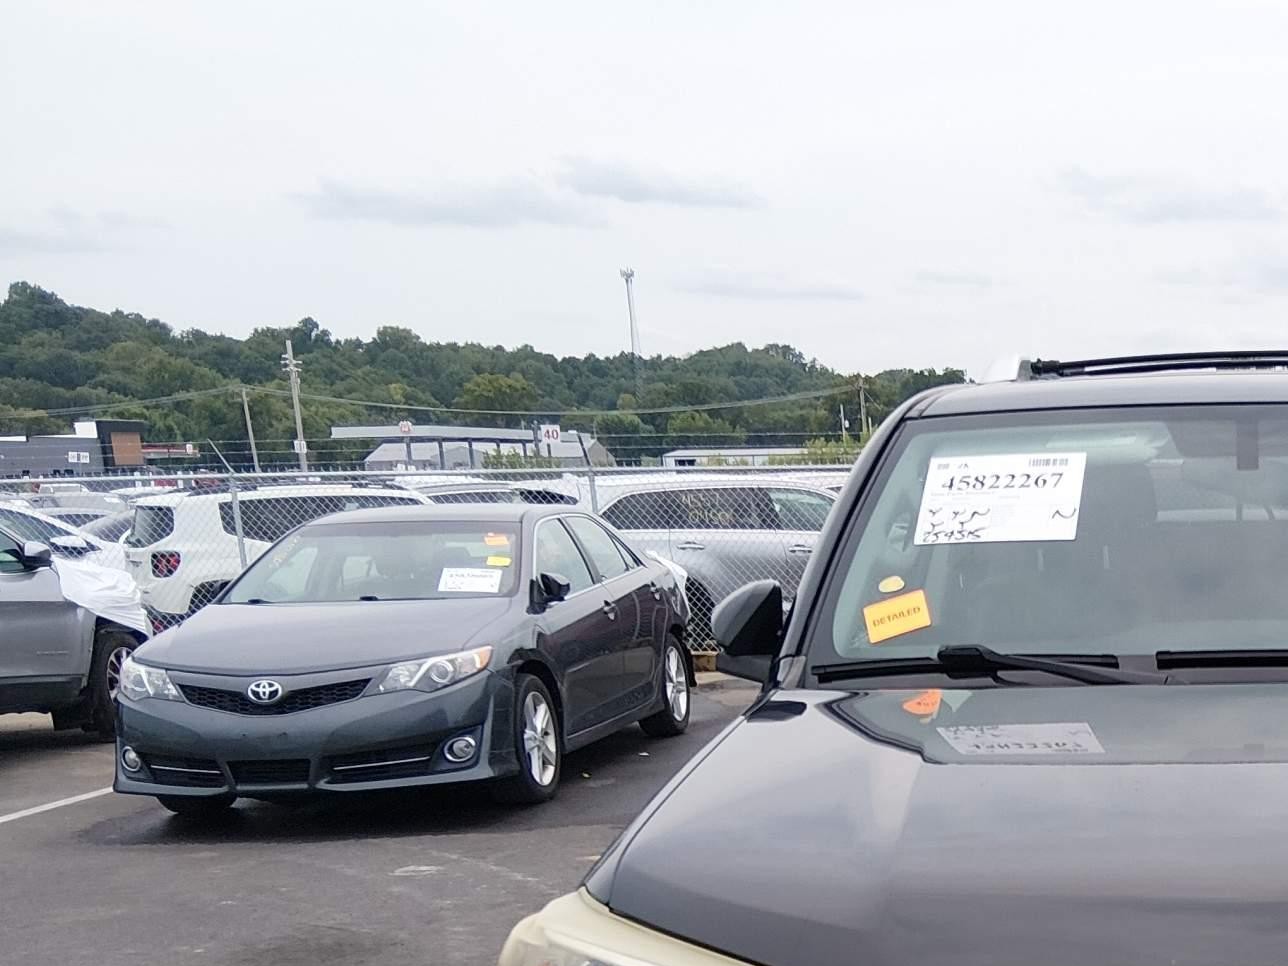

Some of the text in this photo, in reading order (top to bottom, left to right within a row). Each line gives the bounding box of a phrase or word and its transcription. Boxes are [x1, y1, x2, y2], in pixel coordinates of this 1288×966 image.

[544, 430, 559, 441] 40
[942, 472, 1064, 491] 45822267
[872, 605, 921, 628] DETAILED
